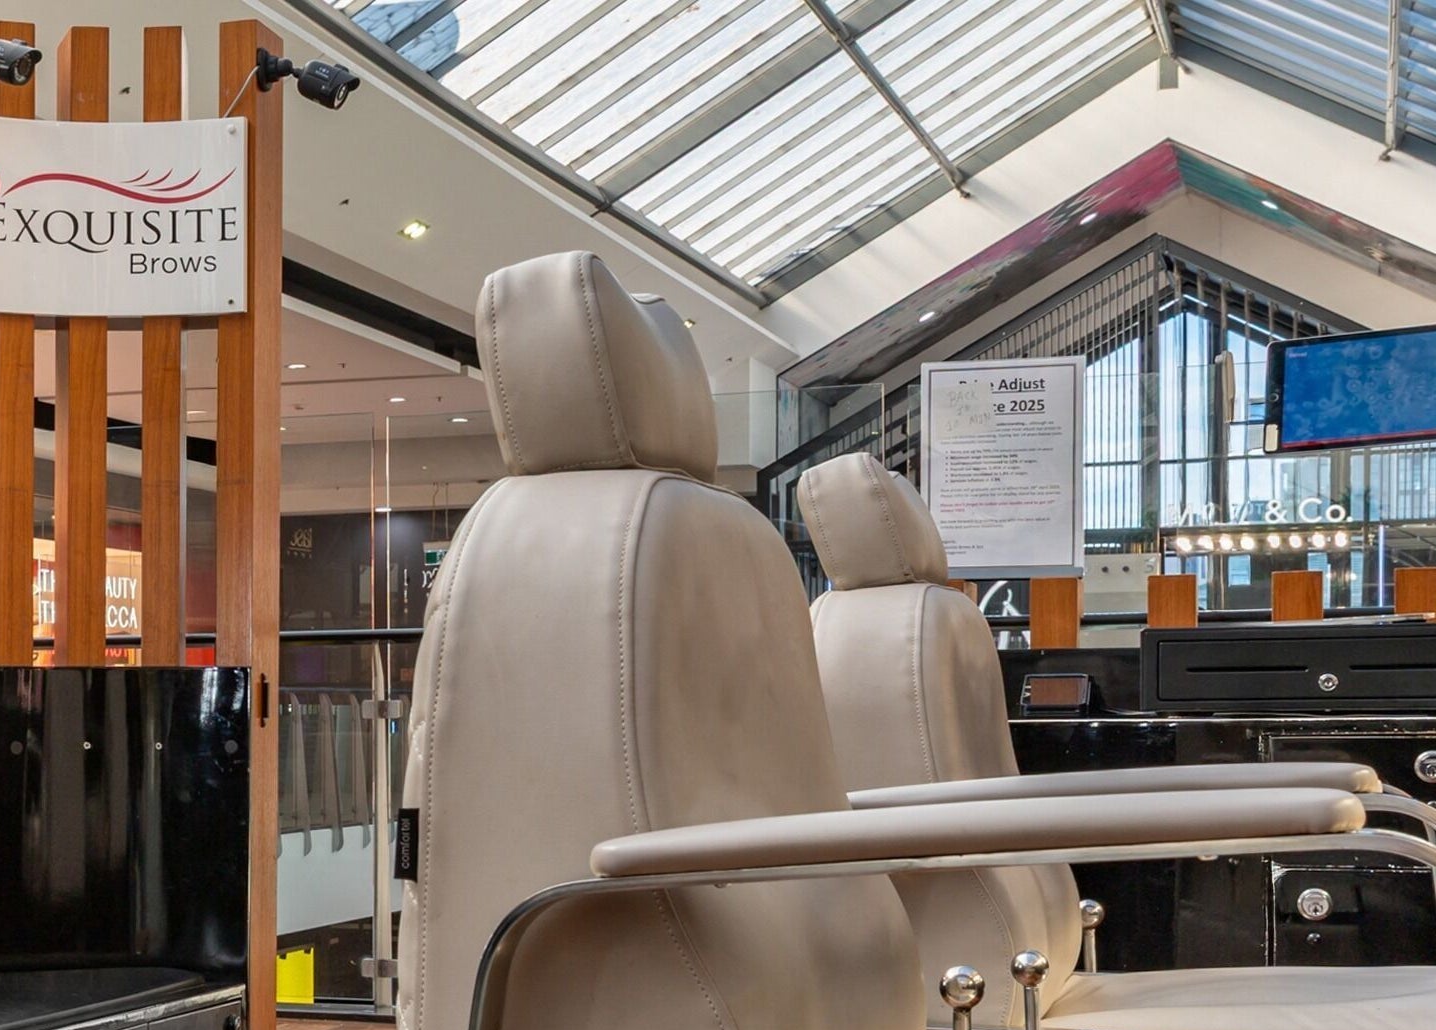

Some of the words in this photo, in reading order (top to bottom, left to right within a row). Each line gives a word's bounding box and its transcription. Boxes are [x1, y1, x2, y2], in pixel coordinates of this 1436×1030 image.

[129, 253, 218, 275] Brows
[998, 377, 1046, 393] Adjust
[1009, 399, 1046, 412] 2025
[1265, 500, 1287, 523] &
[1299, 498, 1353, 523] Co.
